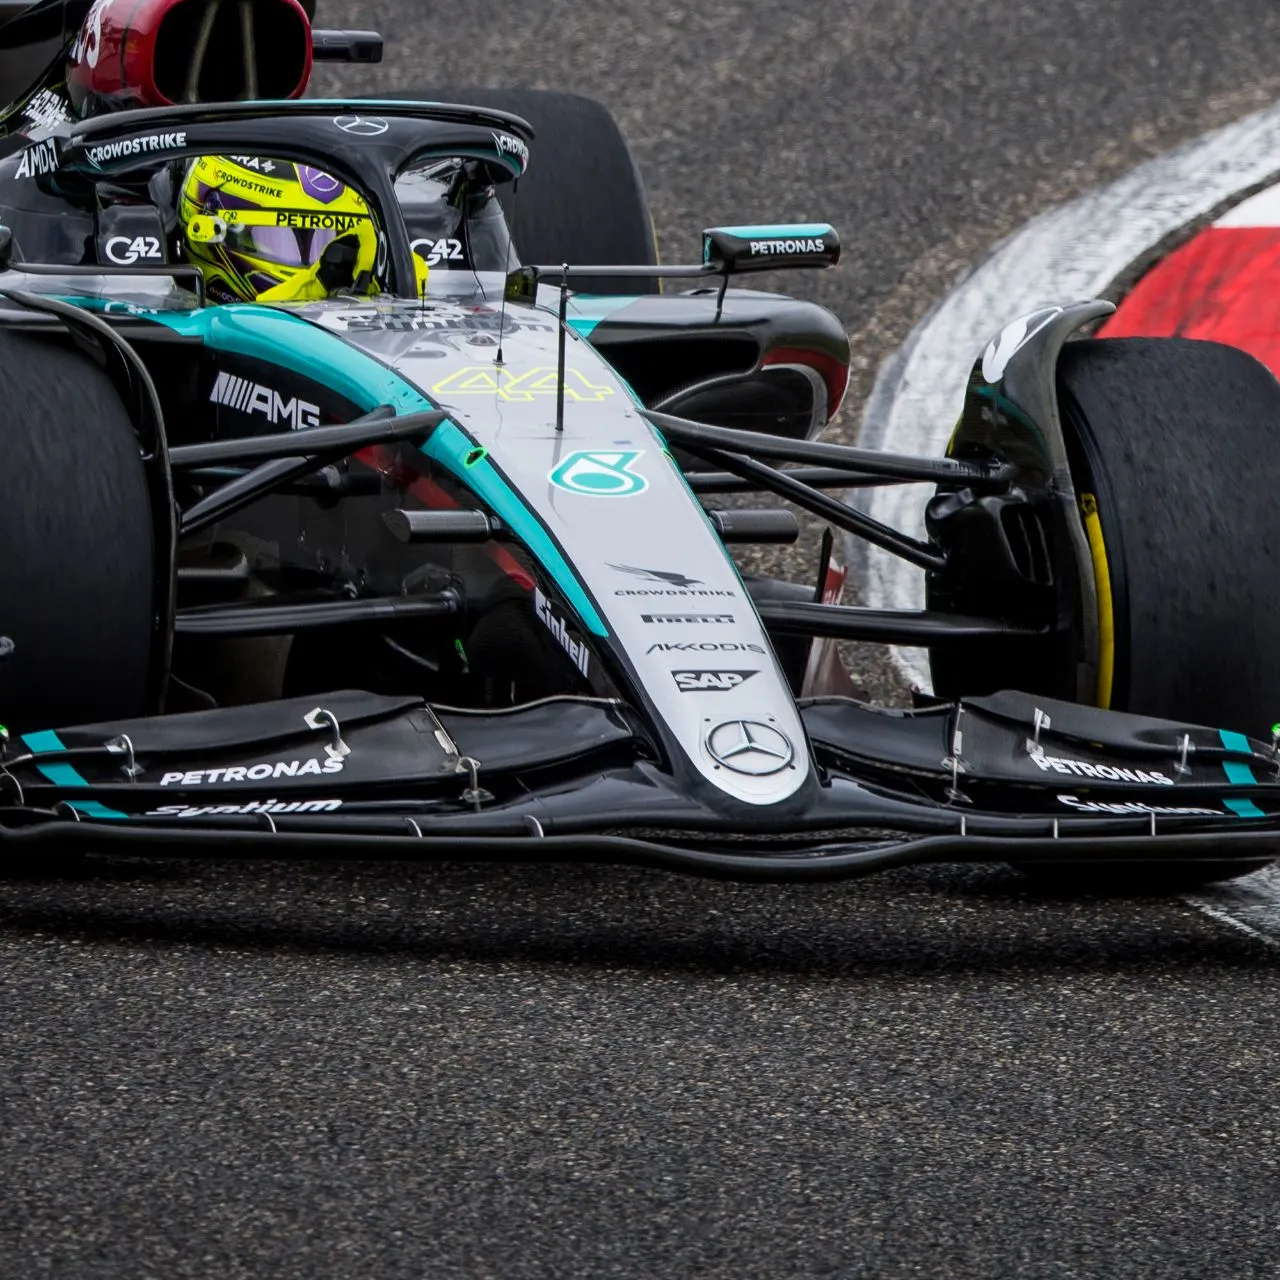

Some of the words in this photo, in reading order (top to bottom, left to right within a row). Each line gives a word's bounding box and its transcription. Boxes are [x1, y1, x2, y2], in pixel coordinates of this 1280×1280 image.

[14, 141, 51, 180] AMD
[89, 131, 187, 163] CROWDSTRIKE
[216, 169, 283, 199] CROWDSTRIKE
[105, 236, 162, 265] G42
[410, 238, 464, 267] G42
[749, 238, 825, 255] PETRONAS
[431, 366, 616, 402] 44
[246, 382, 320, 431] AMG
[614, 589, 736, 598] CROWDSTRIKE
[534, 586, 591, 679] Einhell
[640, 614, 736, 624] PIRELLI
[674, 672, 744, 689] SAP
[159, 756, 345, 787] PETRONAS
[1030, 752, 1175, 786] PETRONAS
